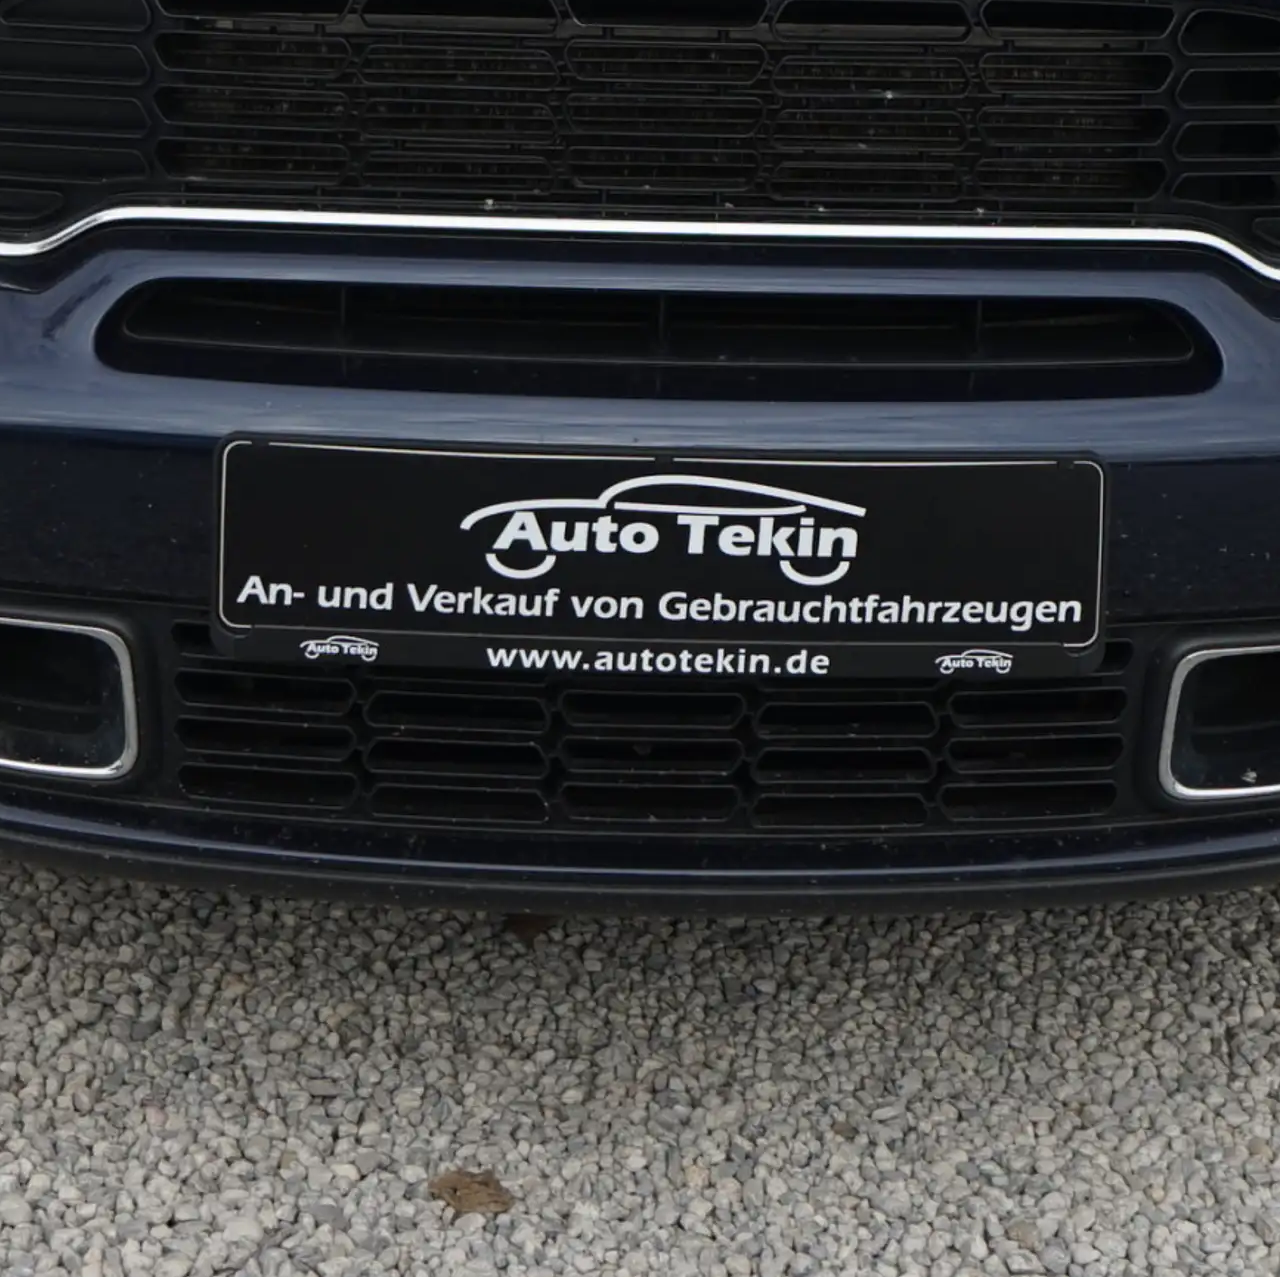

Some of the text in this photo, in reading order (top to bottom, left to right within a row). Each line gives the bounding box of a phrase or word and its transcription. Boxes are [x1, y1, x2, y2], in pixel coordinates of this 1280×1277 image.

[492, 510, 858, 558] Auto Tekin
[237, 575, 1081, 631] An- und Verkauf von Gebrauchtfahrzeugen
[306, 642, 378, 655] Auto Tekin
[487, 646, 829, 675] www.autotekin.de
[941, 657, 1012, 668] Auto Tekin
